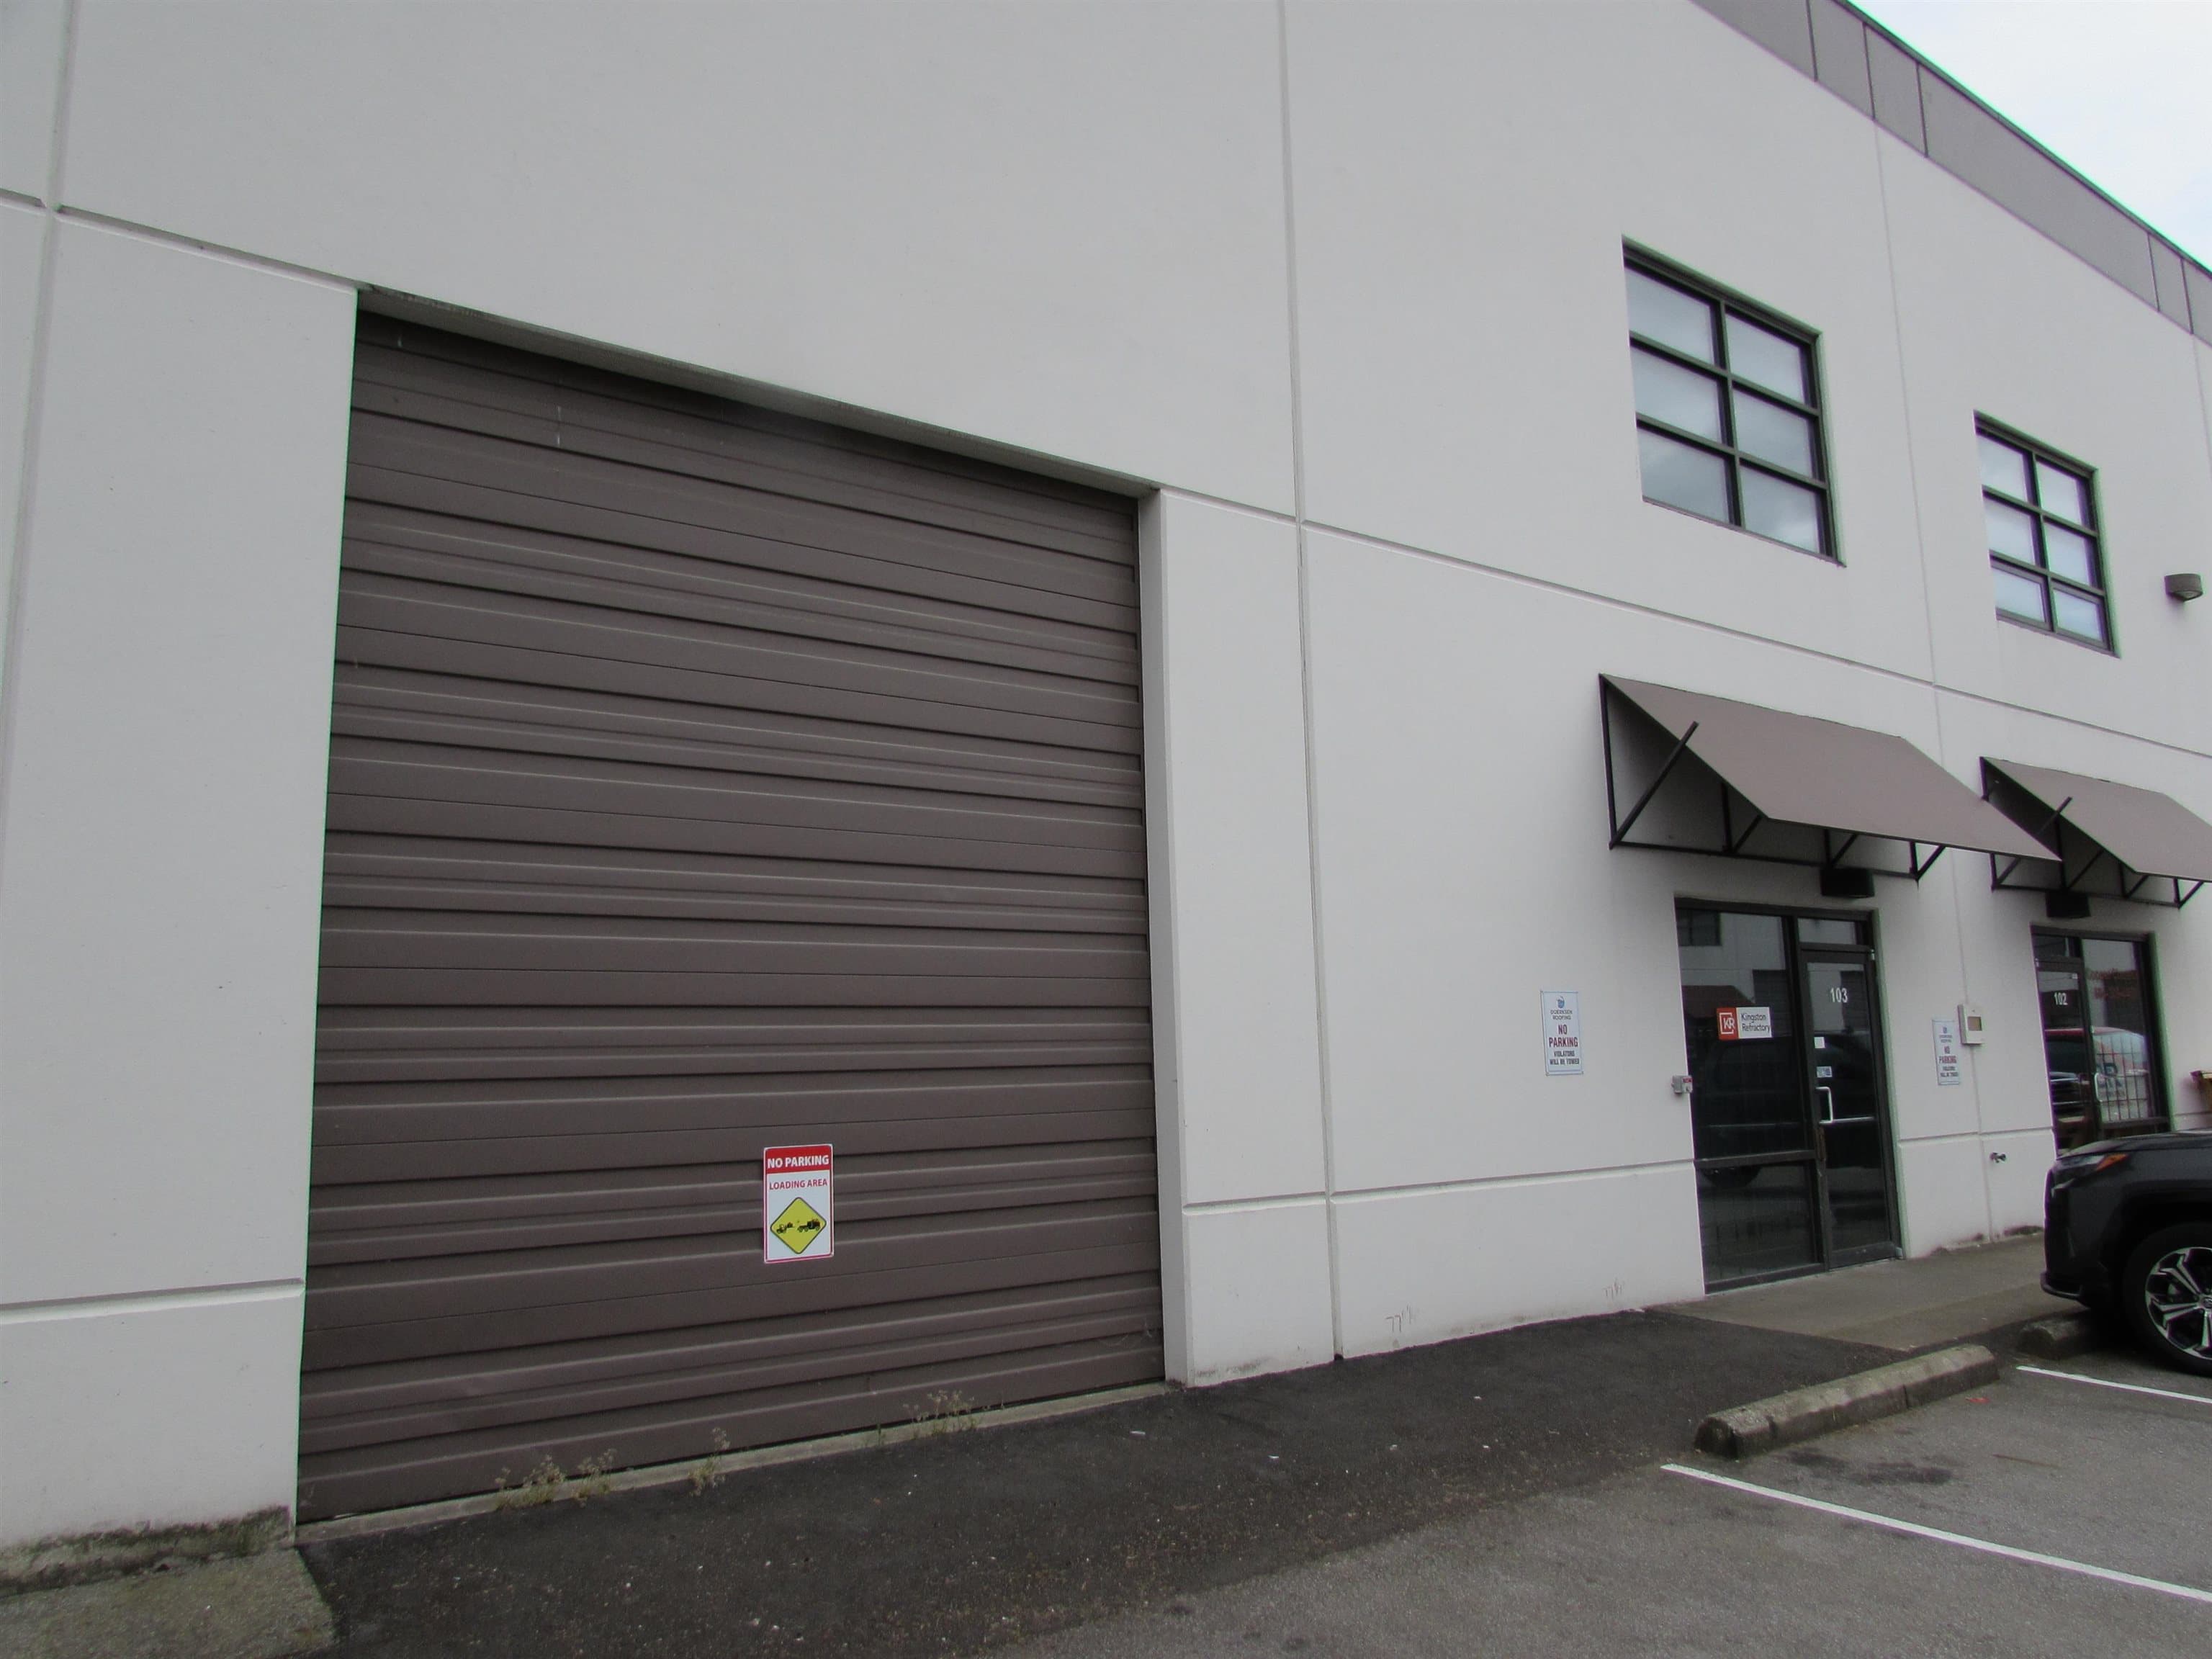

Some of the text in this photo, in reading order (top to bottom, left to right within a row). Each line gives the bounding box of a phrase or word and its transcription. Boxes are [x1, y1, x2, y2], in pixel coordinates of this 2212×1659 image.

[1830, 987, 1848, 1003] 103
[2054, 992, 2068, 1006] 102
[1740, 1012, 1766, 1023] Kingston
[1722, 1017, 1736, 1030] KR
[1741, 1022, 1771, 1033] Refractory
[1558, 1024, 1568, 1035] NO
[1549, 1037, 1578, 1048] PARKING
[768, 1155, 830, 1169] NO PARKING
[769, 1180, 805, 1190] LOADING
